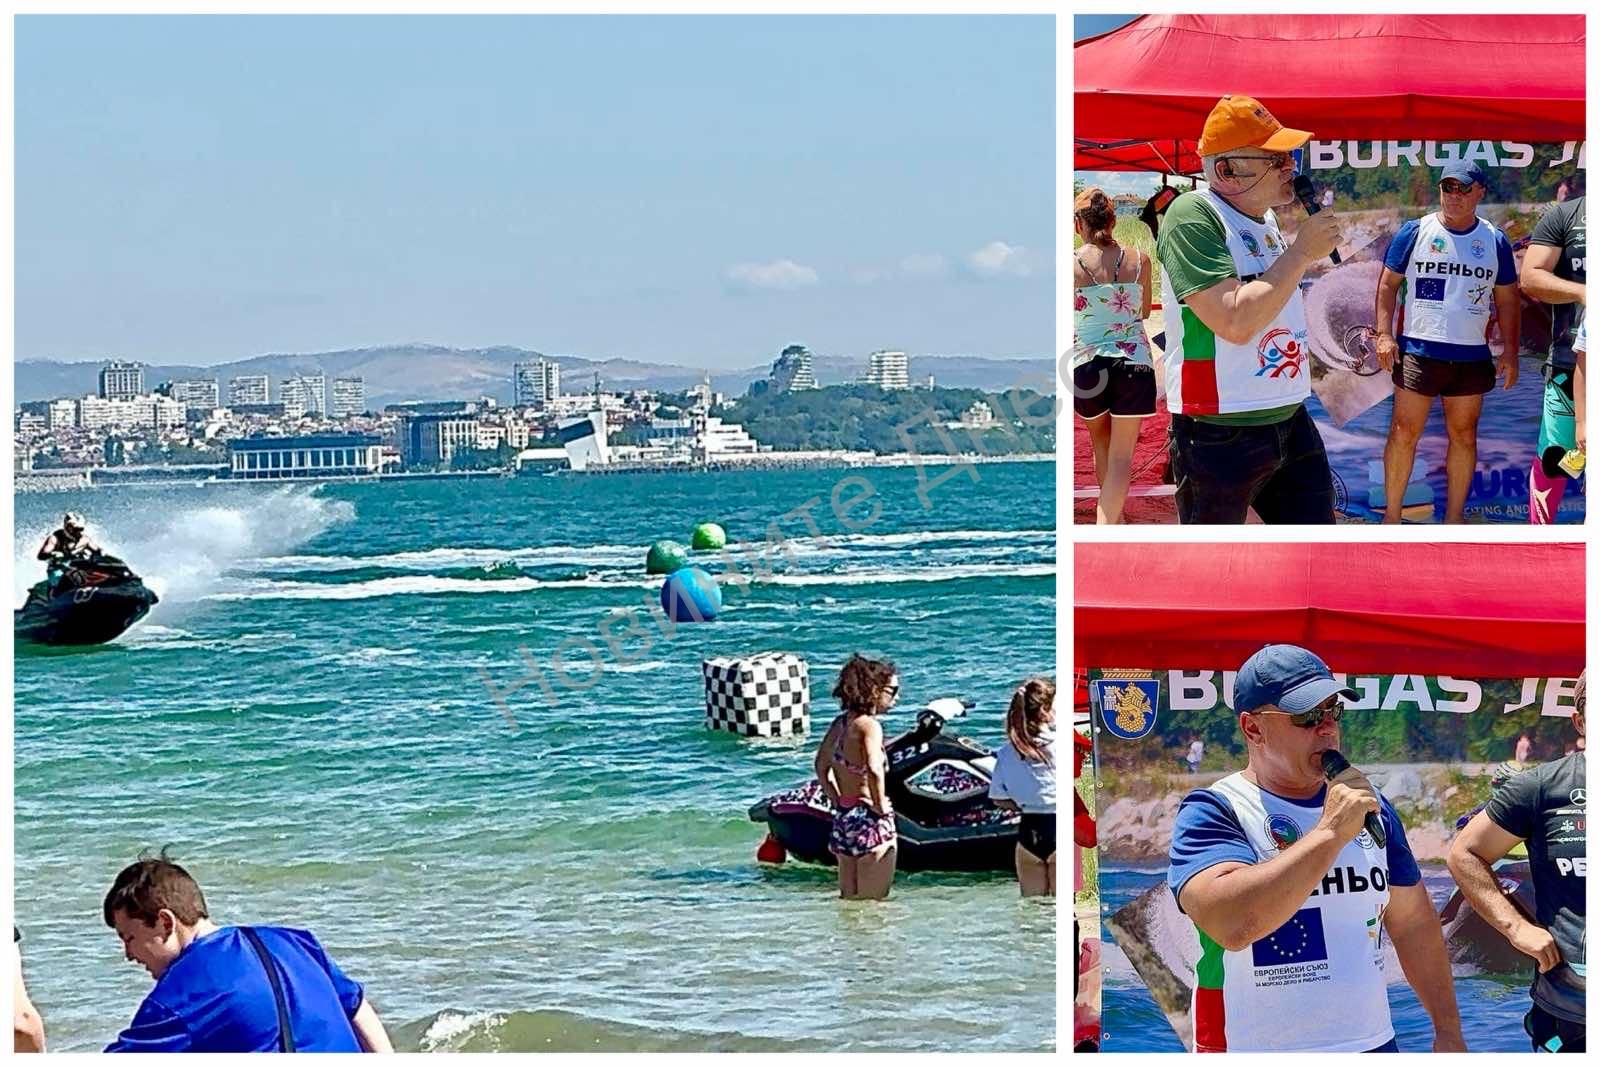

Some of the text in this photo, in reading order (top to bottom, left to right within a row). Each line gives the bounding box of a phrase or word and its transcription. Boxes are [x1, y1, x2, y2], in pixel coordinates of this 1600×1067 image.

[1415, 261, 1494, 281] ТРЕНЬОР
[1254, 963, 1329, 977] ЕВРОПЕЙСКИ СЪЮЗ
